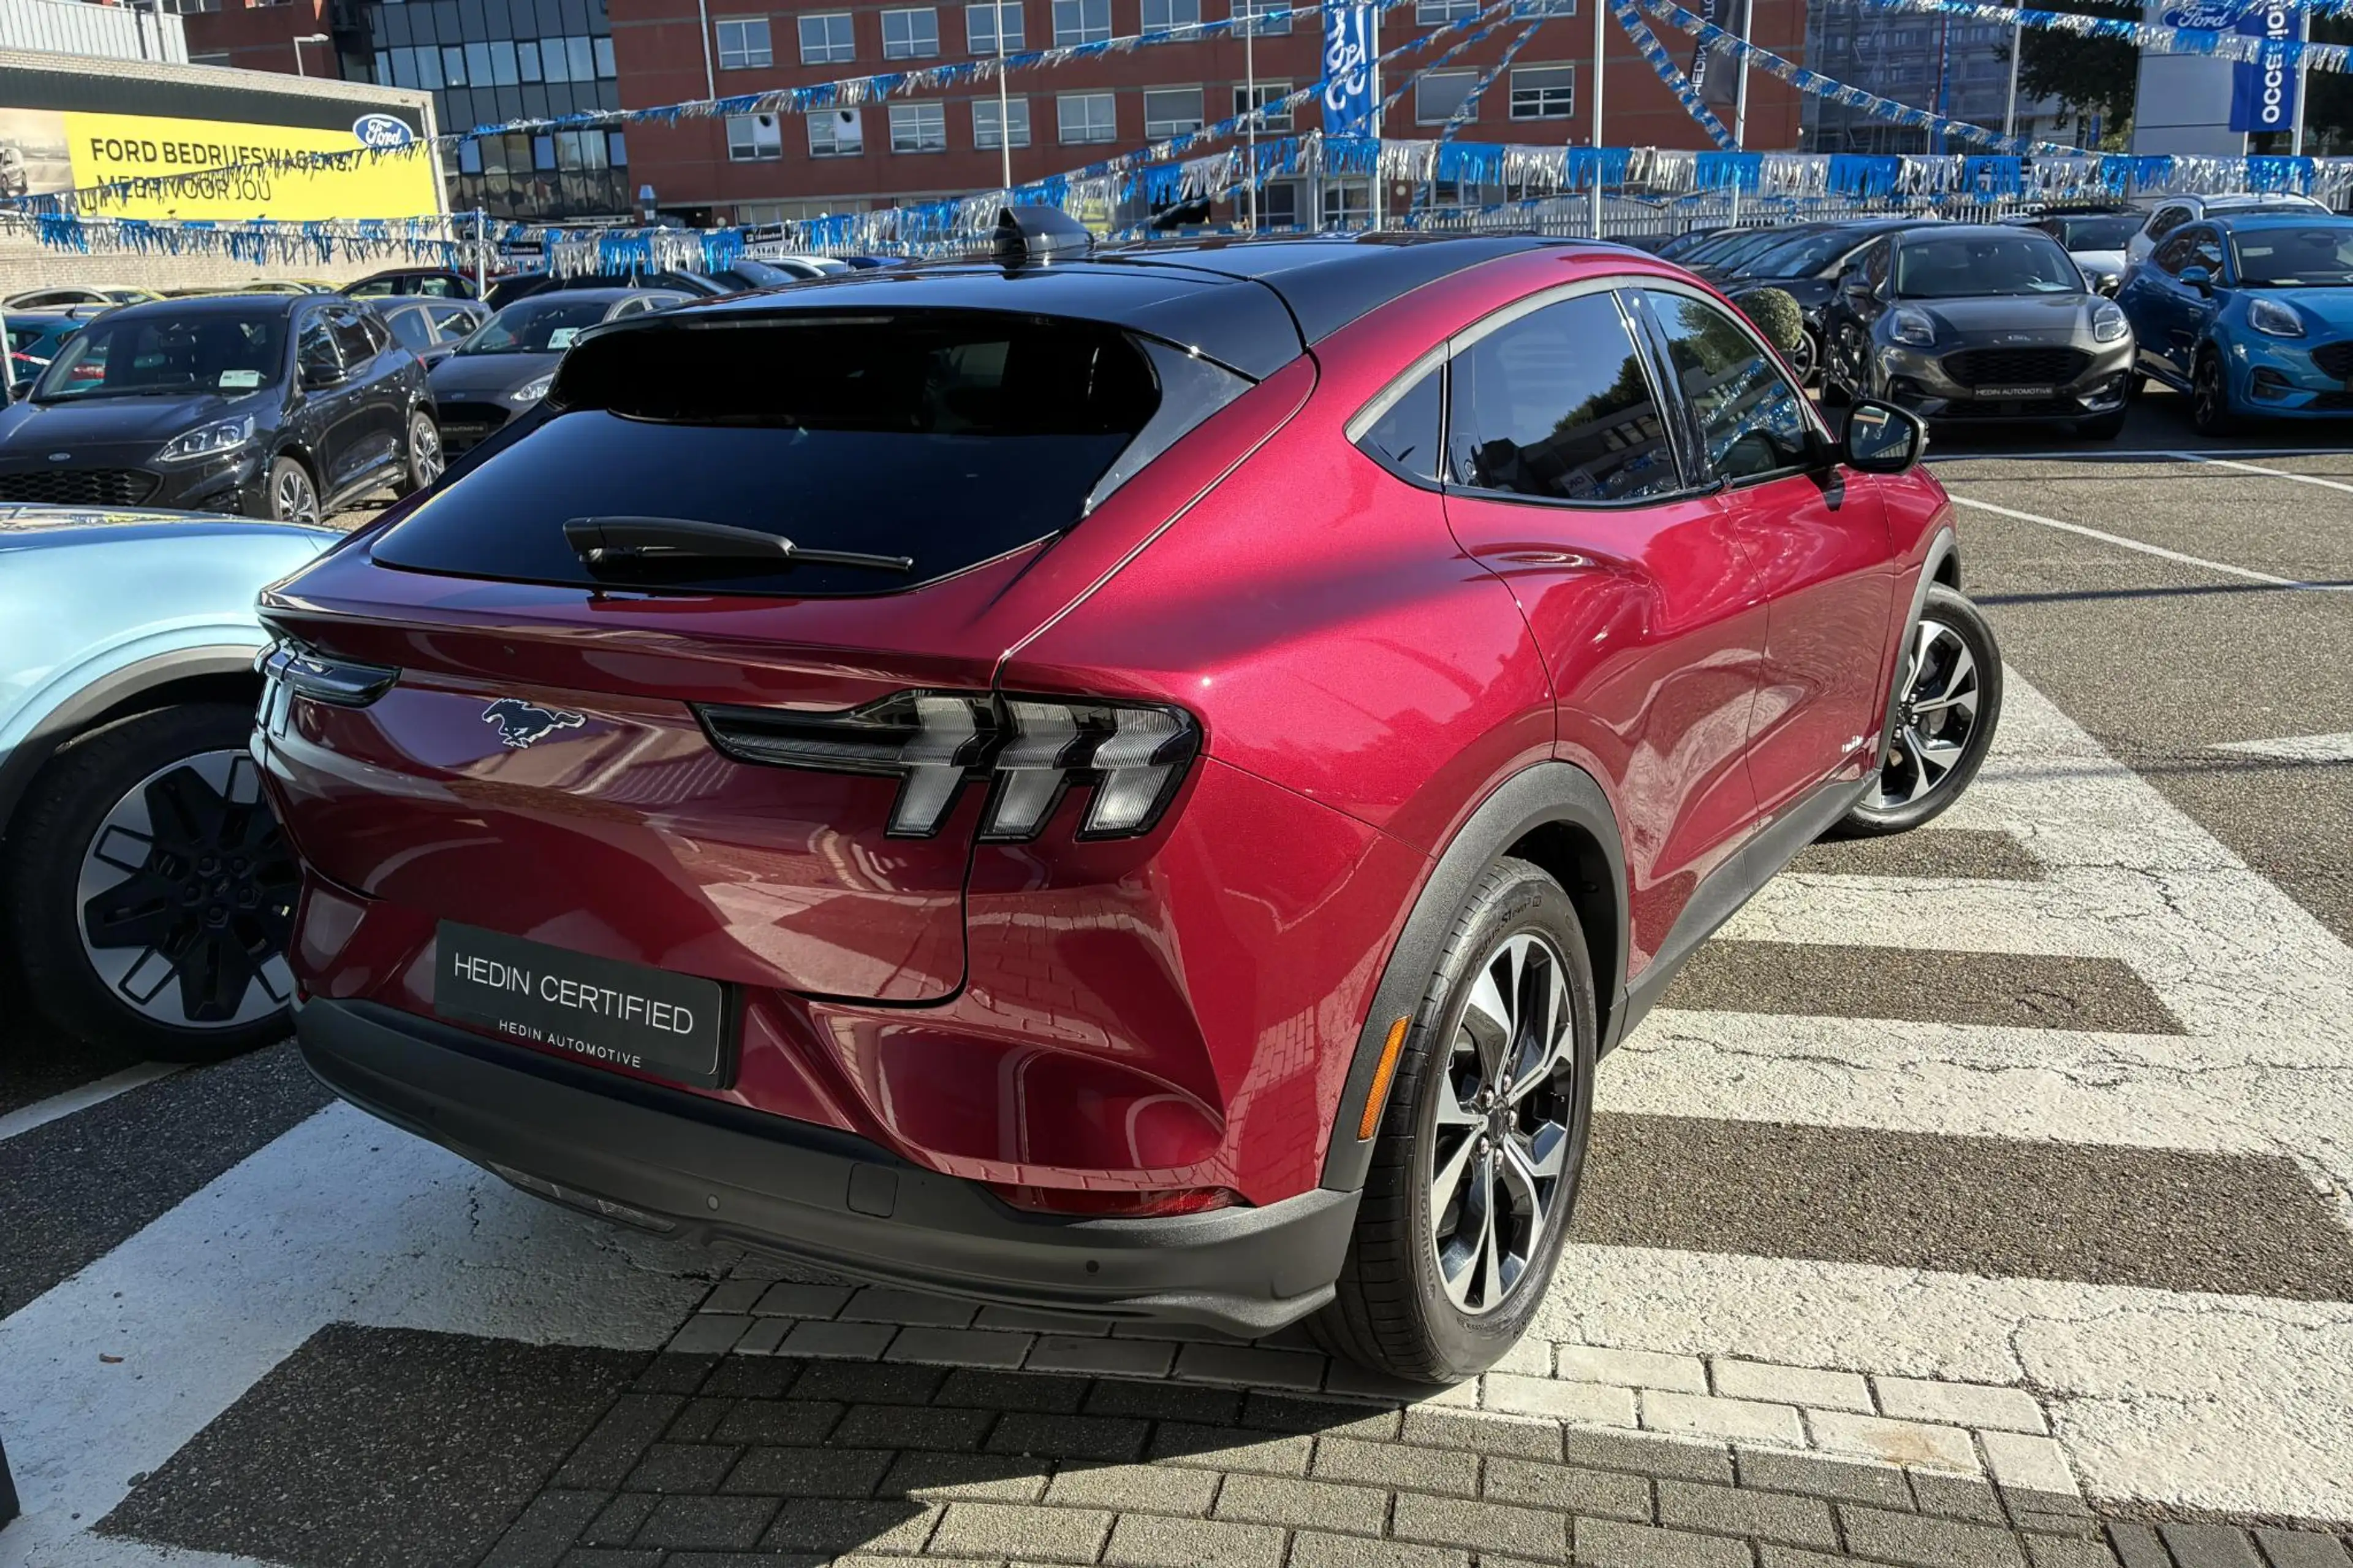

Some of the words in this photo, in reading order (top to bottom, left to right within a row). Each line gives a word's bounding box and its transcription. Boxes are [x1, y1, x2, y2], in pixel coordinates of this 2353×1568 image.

[2178, 5, 2229, 27] Ford
[365, 118, 402, 145] Ford
[91, 138, 157, 162] FORD
[235, 180, 271, 201] JOU
[455, 952, 529, 995] HEDIN
[540, 975, 692, 1034] CERTIFIED
[499, 1019, 541, 1041] HEDIN
[547, 1033, 640, 1068] AUTOMOTIVE
